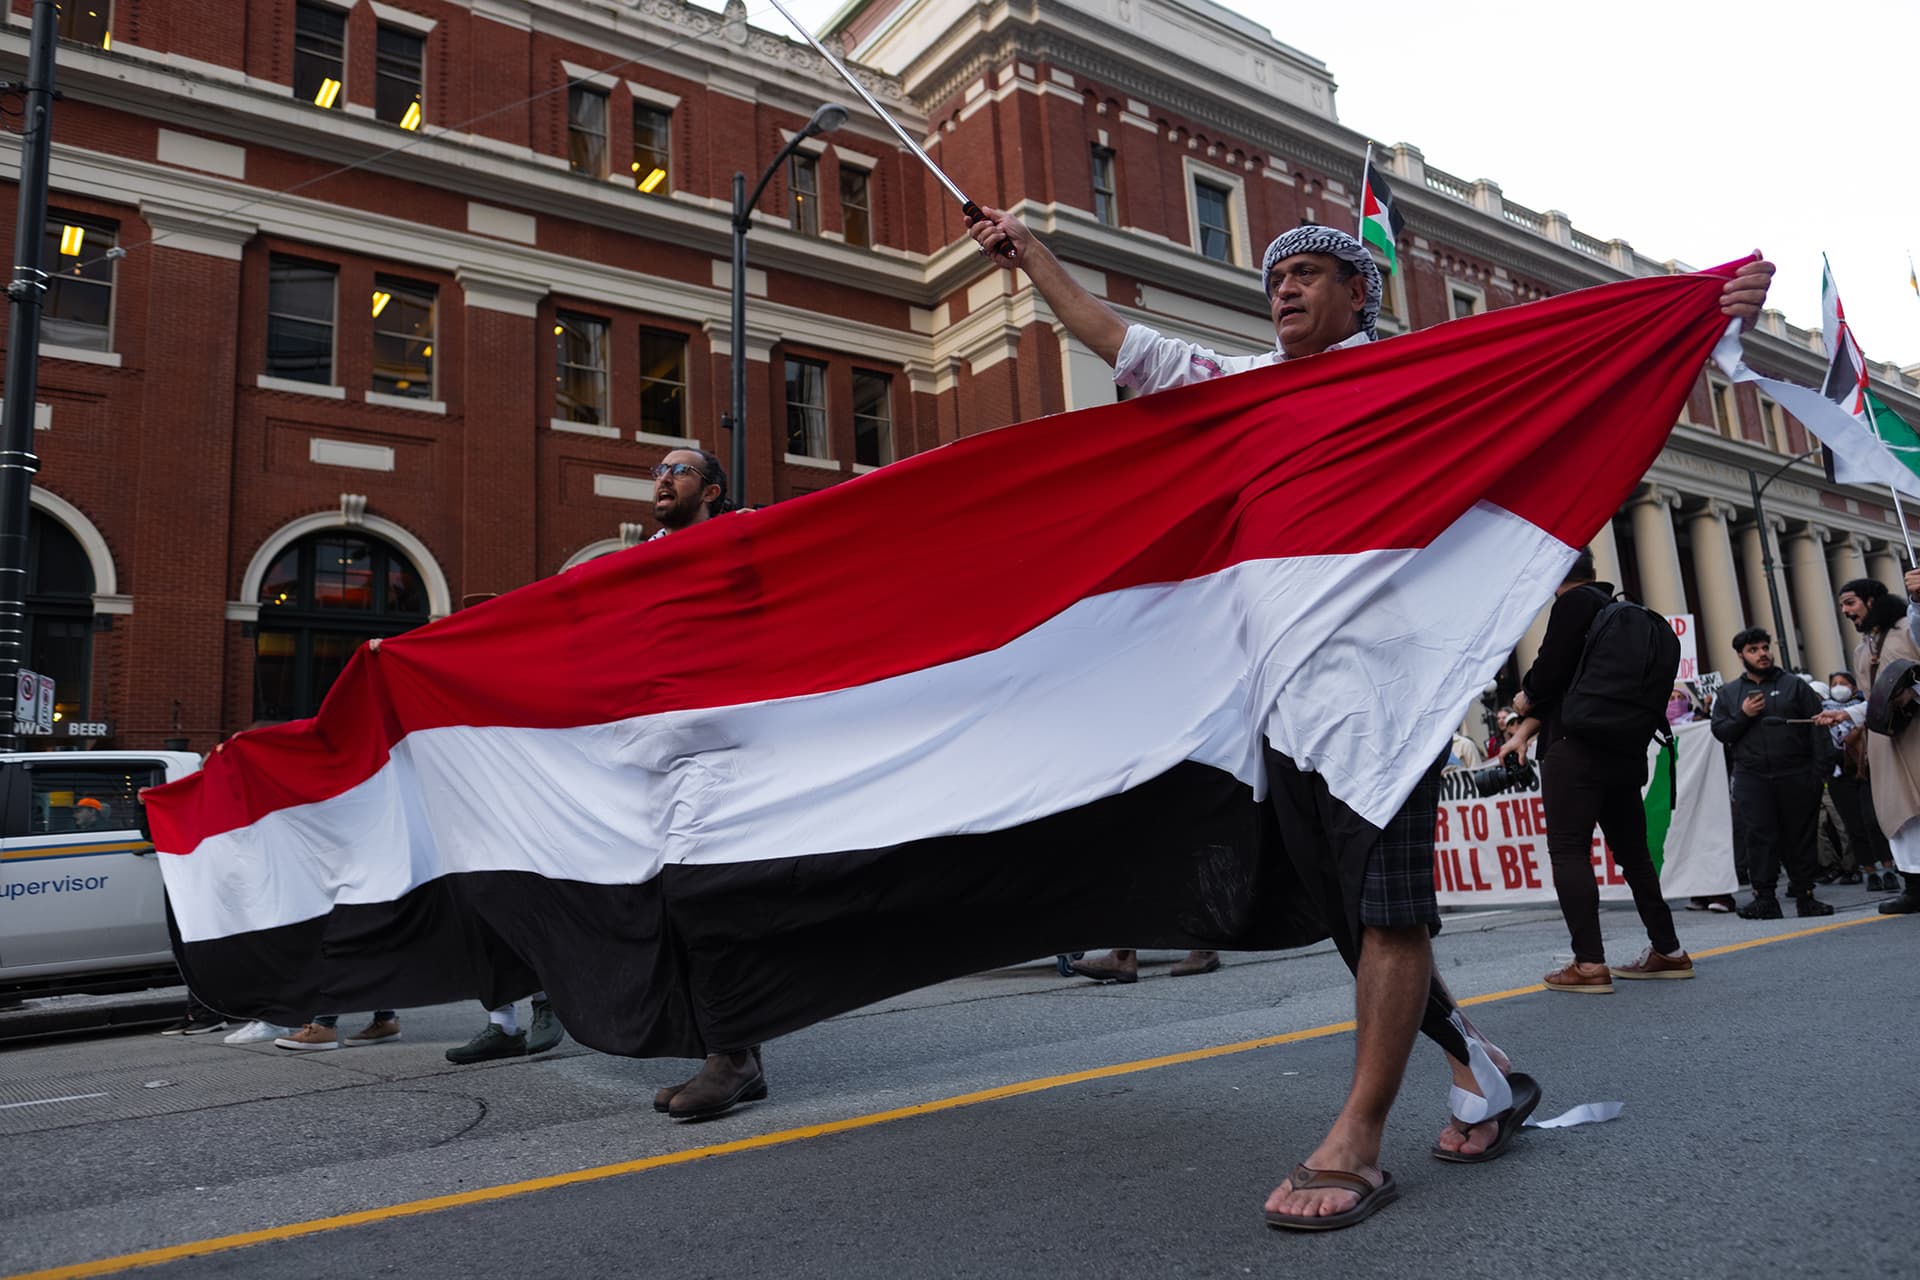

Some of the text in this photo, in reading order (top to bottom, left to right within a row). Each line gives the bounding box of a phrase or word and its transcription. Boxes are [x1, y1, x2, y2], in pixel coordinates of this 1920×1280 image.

[68, 722, 107, 736] BEER
[1457, 804, 1489, 841] TO
[1496, 797, 1547, 839] THE
[1496, 844, 1542, 890] BE
[0, 875, 109, 901] upervisor
